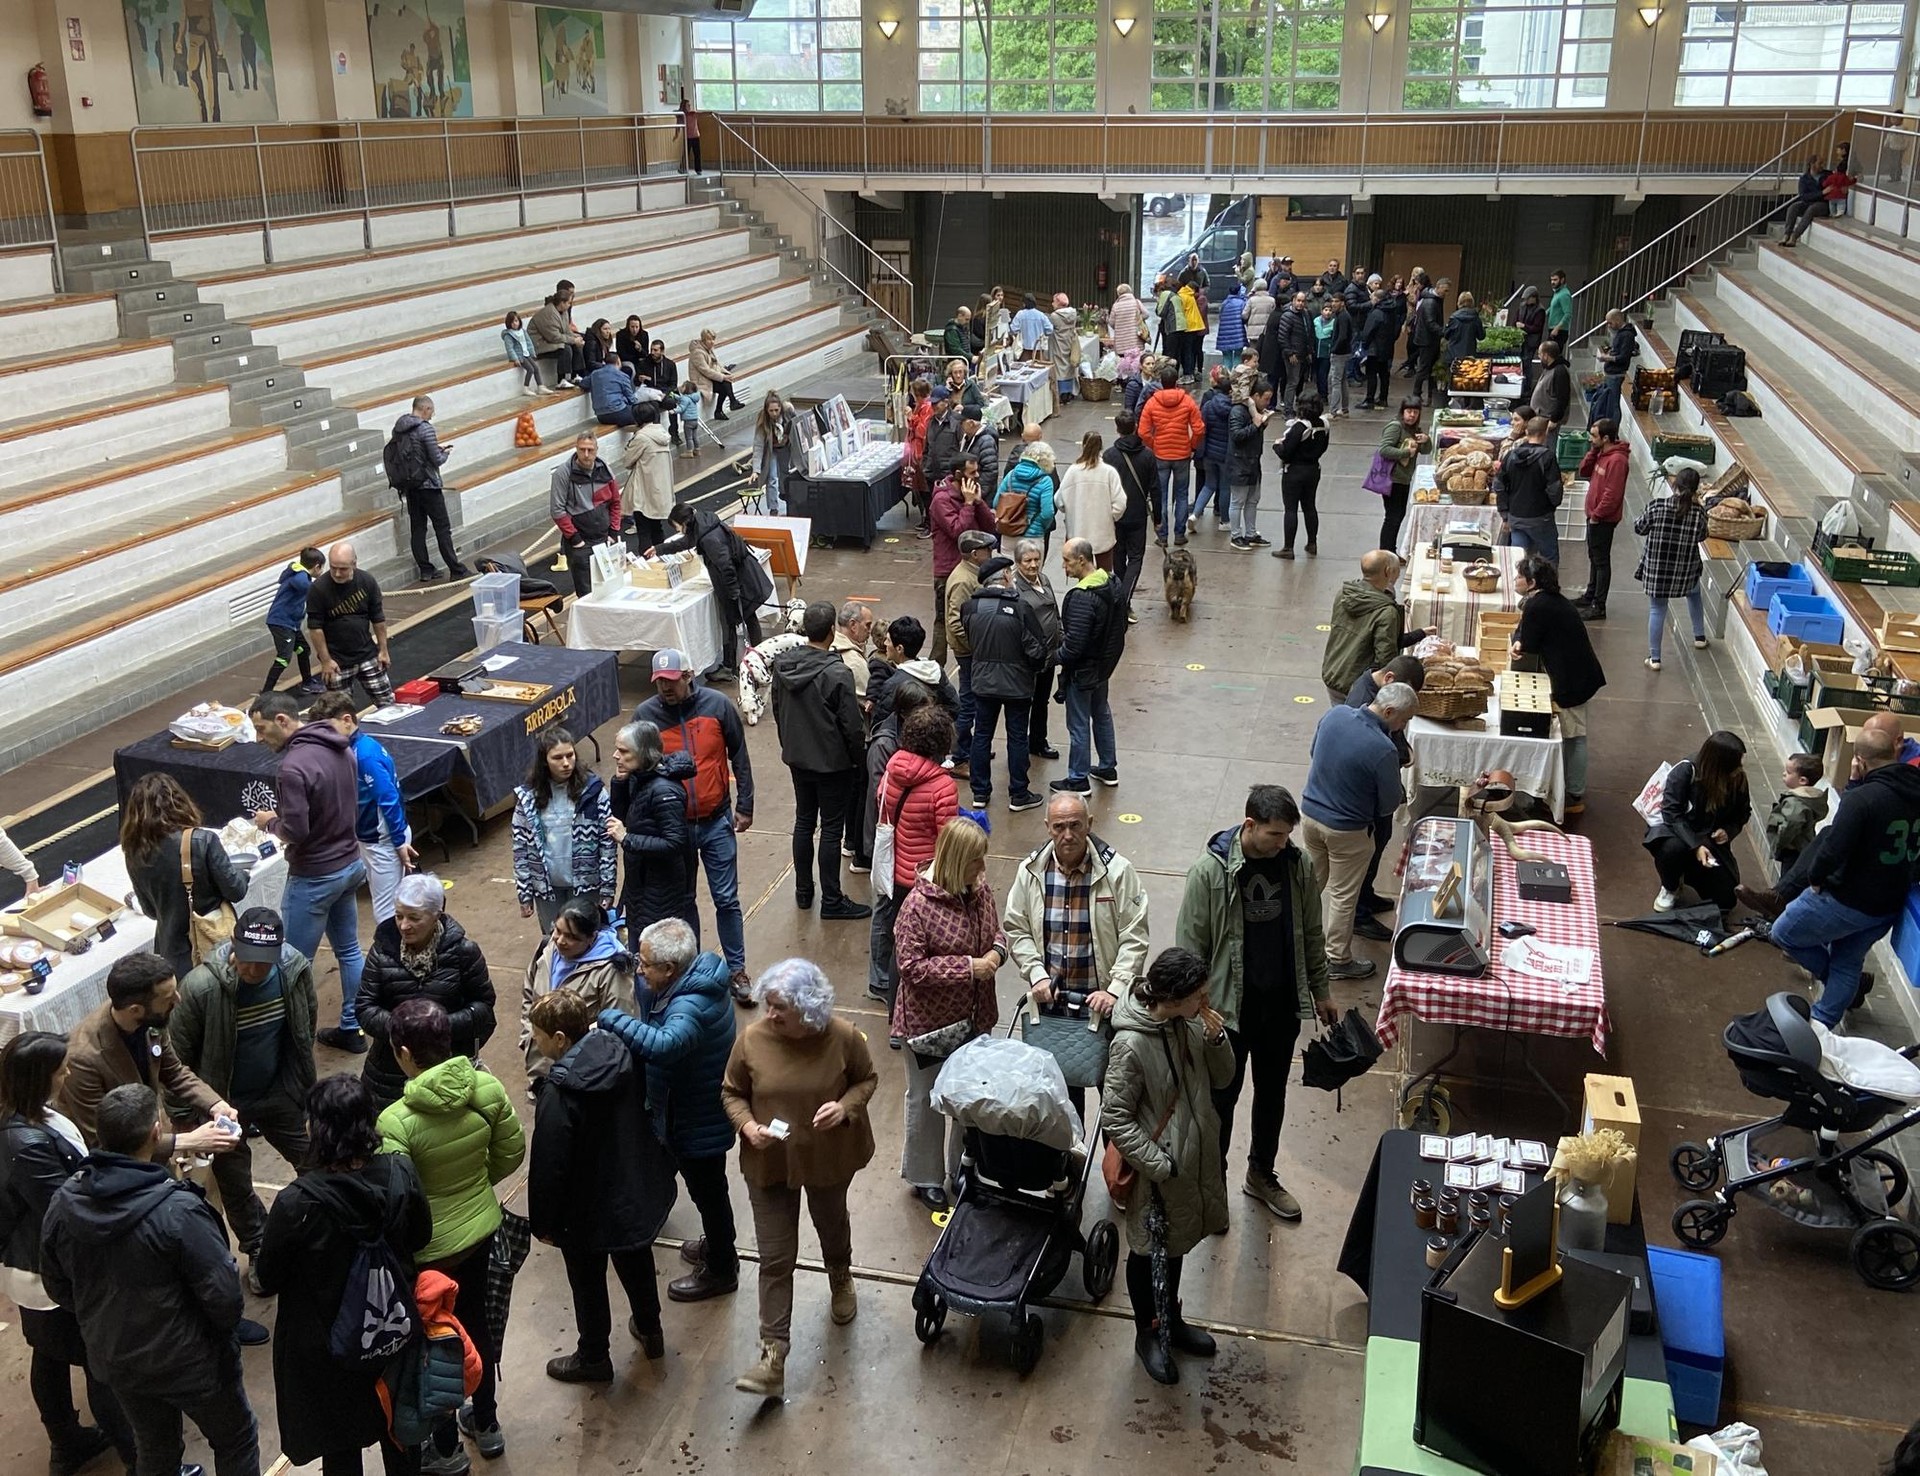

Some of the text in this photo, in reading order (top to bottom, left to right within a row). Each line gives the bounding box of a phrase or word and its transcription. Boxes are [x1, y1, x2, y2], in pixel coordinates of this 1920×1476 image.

[524, 686, 576, 736] ARRABOLA
[243, 930, 277, 941] ROSE HALL
